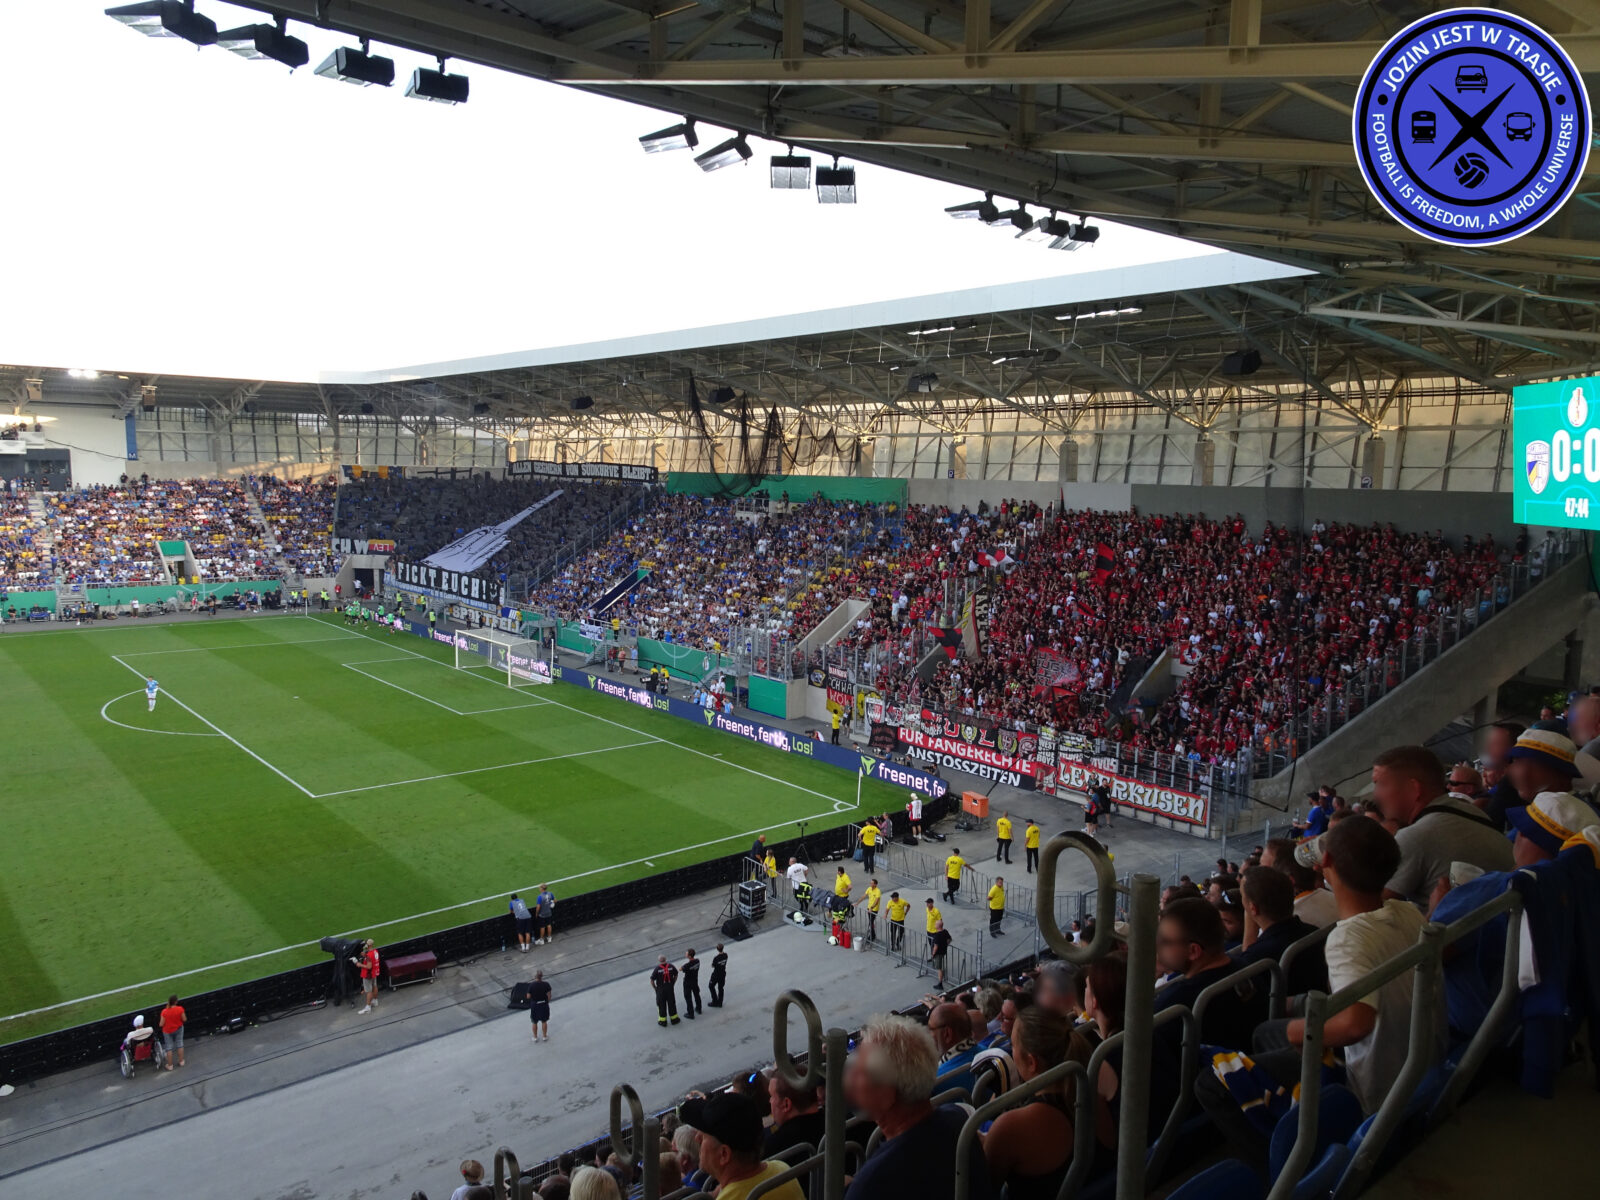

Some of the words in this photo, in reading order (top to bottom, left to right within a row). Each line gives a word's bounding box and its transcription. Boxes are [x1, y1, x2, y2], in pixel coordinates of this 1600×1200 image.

[513, 462, 532, 474] ALLEN
[1564, 497, 1589, 518] 47:44
[398, 562, 436, 587] FICKT
[442, 571, 486, 600] EUCH!
[597, 679, 628, 701] freenet,
[654, 696, 670, 711] los!
[717, 714, 758, 742] freenet,
[758, 727, 791, 752] fertig,
[792, 736, 813, 756] los!
[878, 763, 932, 796] freenet,
[906, 746, 1021, 787] ANSTOSSZEITEN
